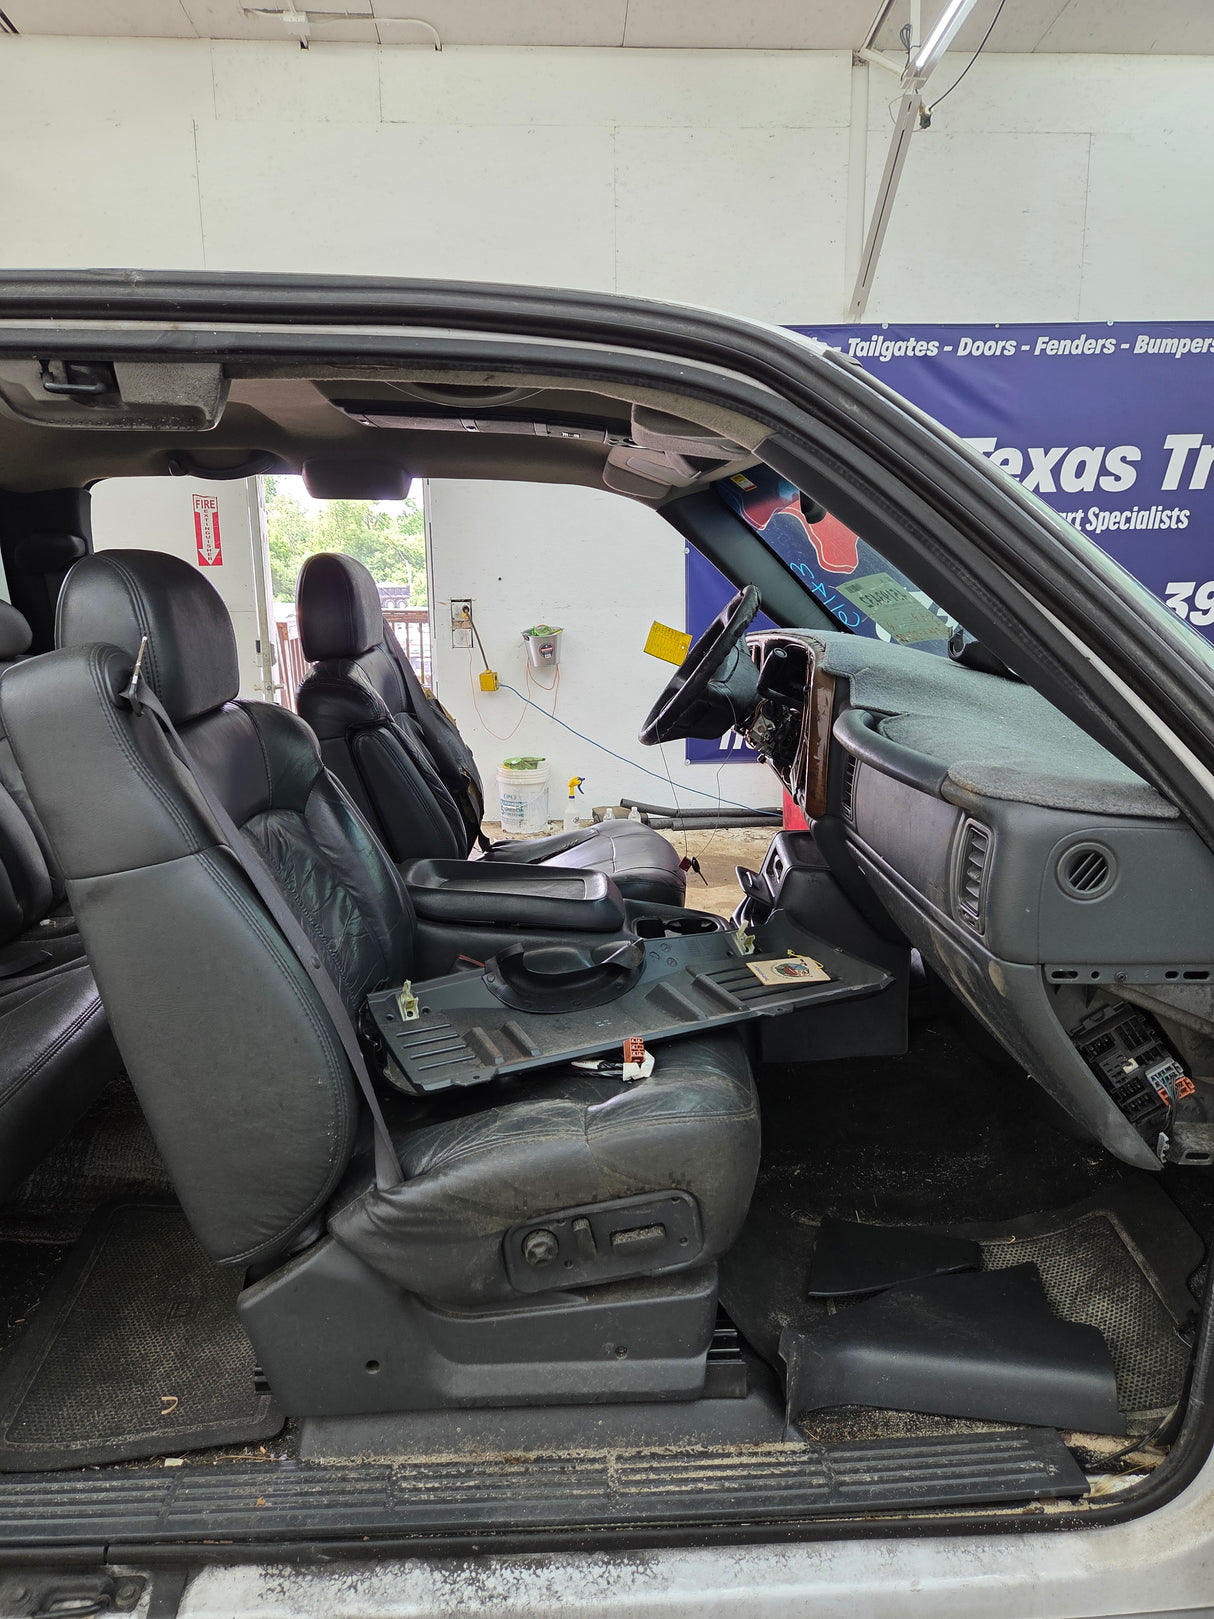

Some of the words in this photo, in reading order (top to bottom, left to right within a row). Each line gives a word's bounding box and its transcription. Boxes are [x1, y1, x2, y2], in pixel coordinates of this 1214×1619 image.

[848, 334, 939, 362] Tailgates
[957, 337, 1017, 356] Doors
[1034, 334, 1117, 355] Fenders
[195, 499, 216, 509] FIRE
[1085, 506, 1190, 533] Specialists
[203, 509, 213, 561] EXTINGUISHER
